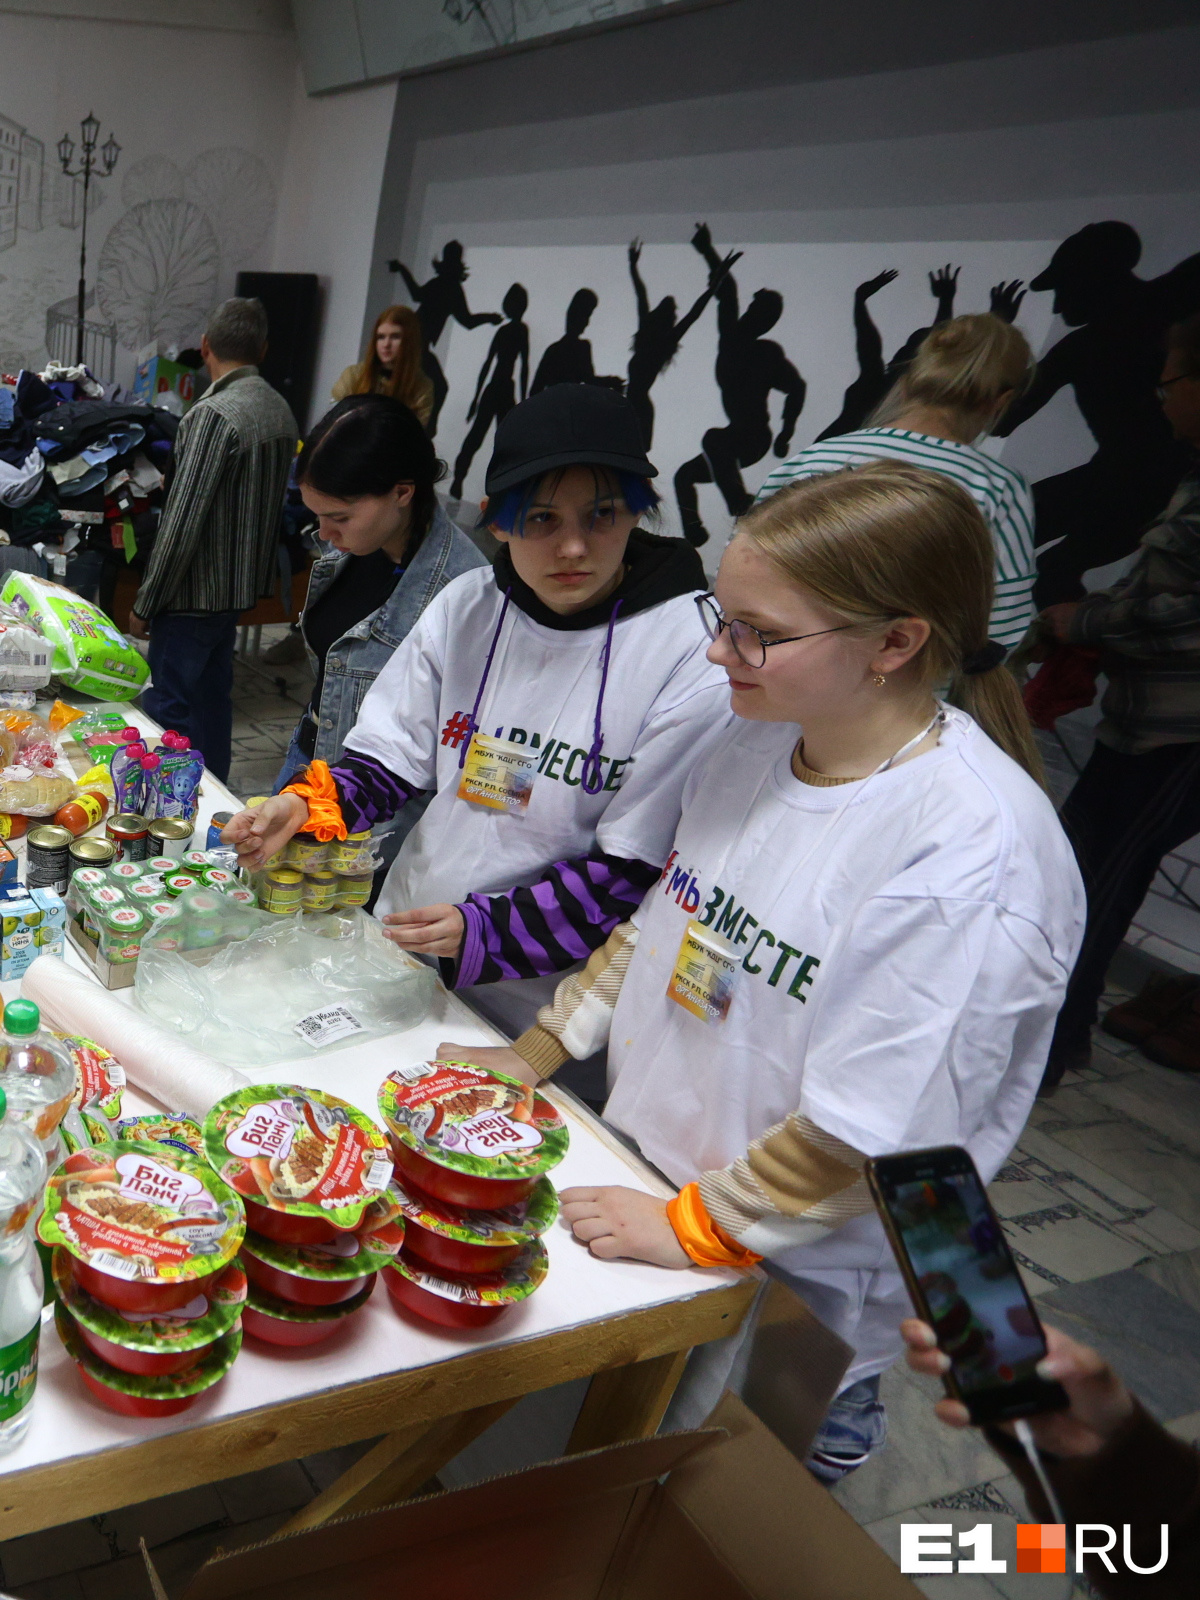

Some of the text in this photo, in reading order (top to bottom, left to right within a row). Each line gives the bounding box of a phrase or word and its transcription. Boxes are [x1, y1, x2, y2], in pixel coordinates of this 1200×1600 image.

[474, 749, 494, 759] МБУК
[466, 786, 521, 806] ОРГАНИЗАТОР
[686, 938, 705, 953] МБУК
[675, 972, 691, 987] РКСК
[675, 984, 720, 1018] ОРГАНИЗАТОР
[241, 1115, 273, 1146] Биг
[465, 1115, 508, 1136] Ланч
[261, 1120, 291, 1154] Ланч
[477, 1127, 524, 1148] Биг
[135, 1164, 183, 1192] Биг
[125, 1178, 179, 1204] Ланч
